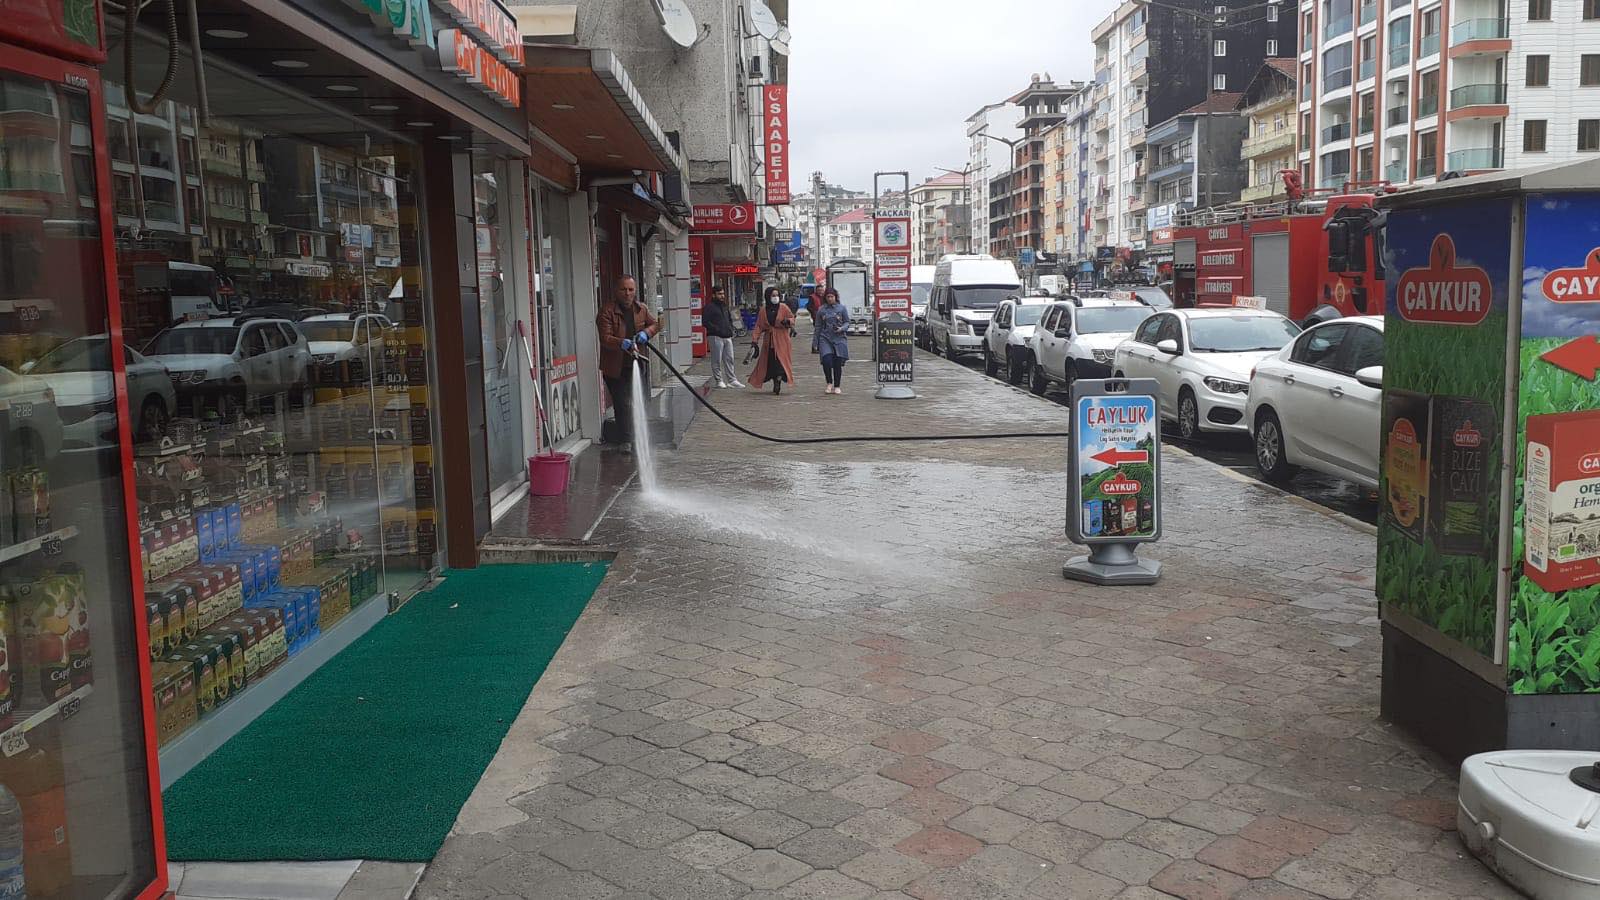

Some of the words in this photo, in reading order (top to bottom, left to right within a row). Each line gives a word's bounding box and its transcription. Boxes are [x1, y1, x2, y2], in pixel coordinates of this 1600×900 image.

[769, 103, 782, 180] SAADET
[694, 208, 724, 217] AIRLINES
[1208, 227, 1228, 242] ÇAYELİ
[1203, 252, 1235, 266] BELEDİYESİ
[1404, 281, 1482, 315] ÇAYKUR
[901, 329, 912, 337] OTO
[880, 363, 893, 372] RENT
[894, 363, 899, 372] A
[900, 362, 912, 372] CAR
[1087, 405, 1148, 428] ÇAYLUK
